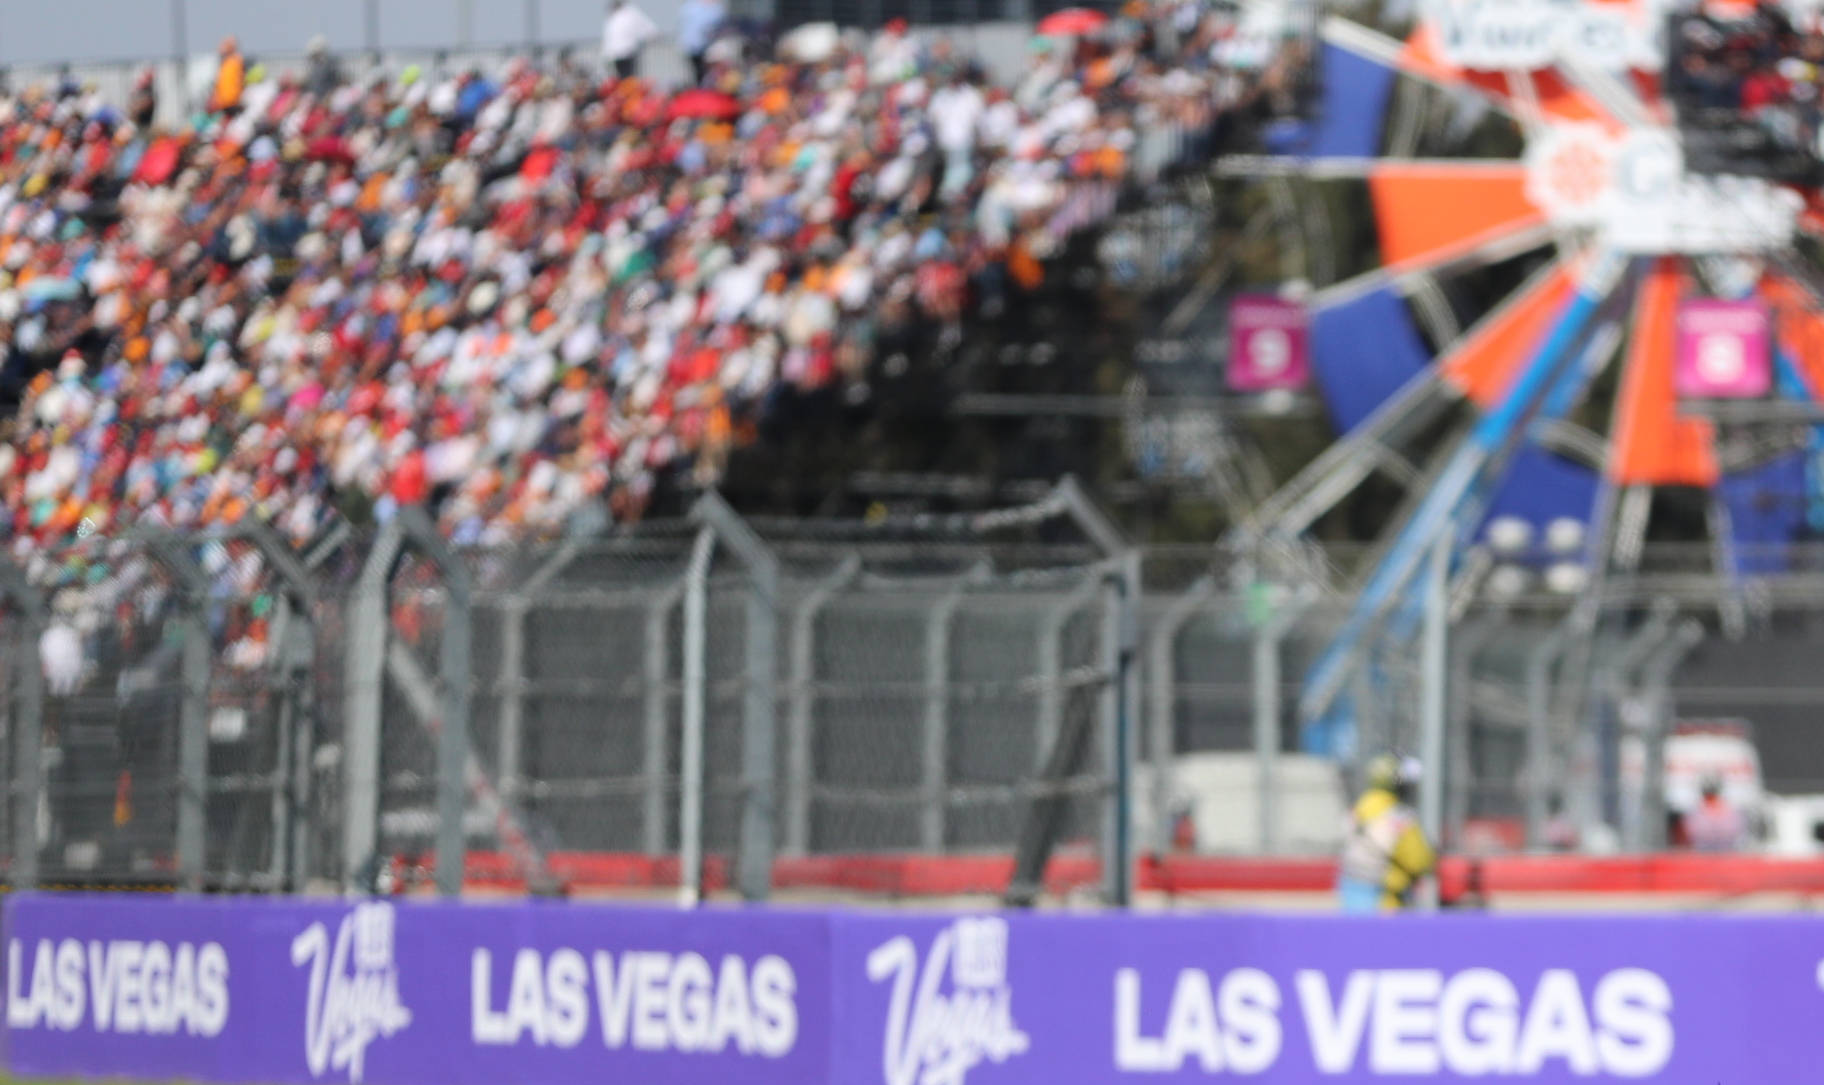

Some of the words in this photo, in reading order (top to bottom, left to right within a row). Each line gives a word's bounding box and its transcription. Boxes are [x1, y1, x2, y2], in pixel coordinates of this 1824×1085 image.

[7, 940, 87, 1031] LAS
[89, 940, 229, 1037] VEGAS
[472, 948, 590, 1048] LAS
[593, 950, 799, 1058] VEGAS
[1114, 967, 1284, 1073] LAS
[1296, 967, 1676, 1077] VEGAS
